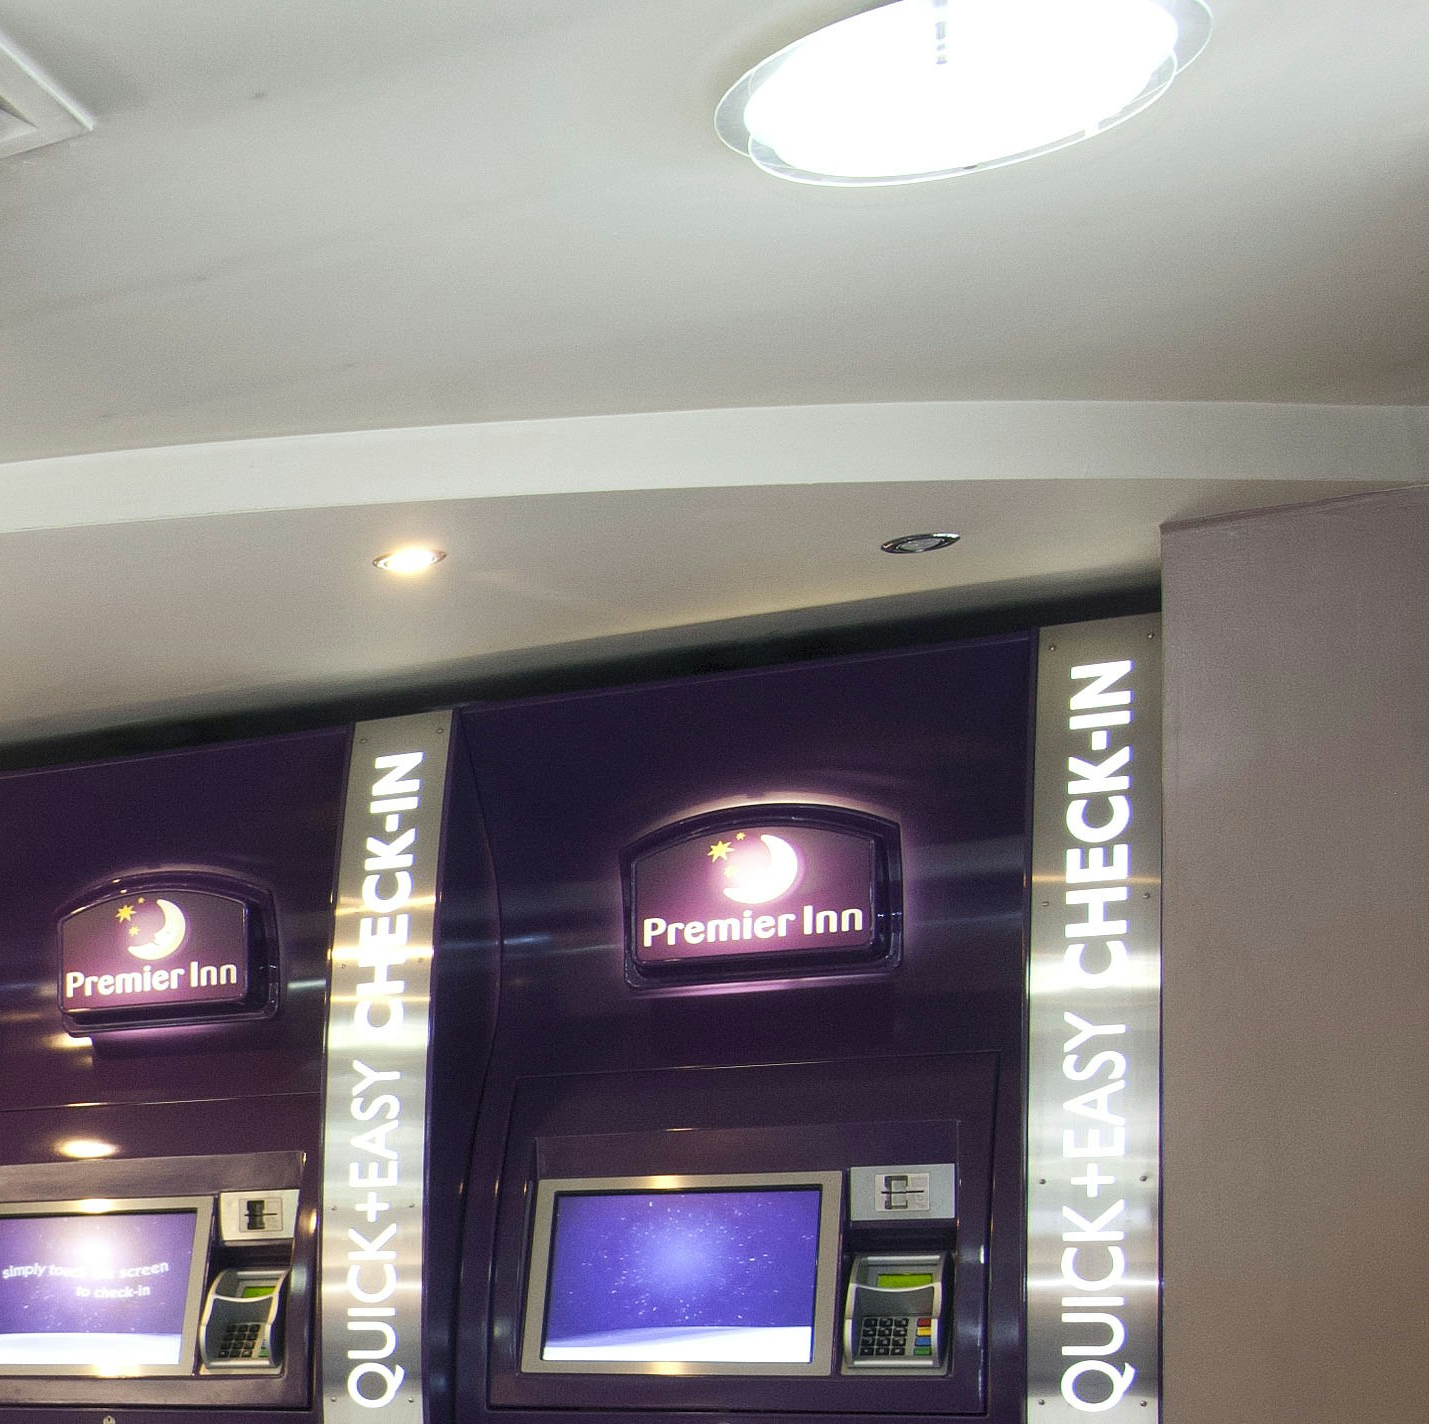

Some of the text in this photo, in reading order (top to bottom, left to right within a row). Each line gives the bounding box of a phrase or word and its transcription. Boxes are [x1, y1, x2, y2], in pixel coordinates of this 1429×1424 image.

[1063, 660, 1134, 988] CHECK-IN
[353, 751, 425, 1040] CHECK-IN
[643, 905, 863, 947] Premier Inn
[66, 961, 237, 998] Premier Inn
[2, 1262, 46, 1280] simply
[119, 1261, 169, 1279] screen
[75, 1285, 150, 1299] to check-in
